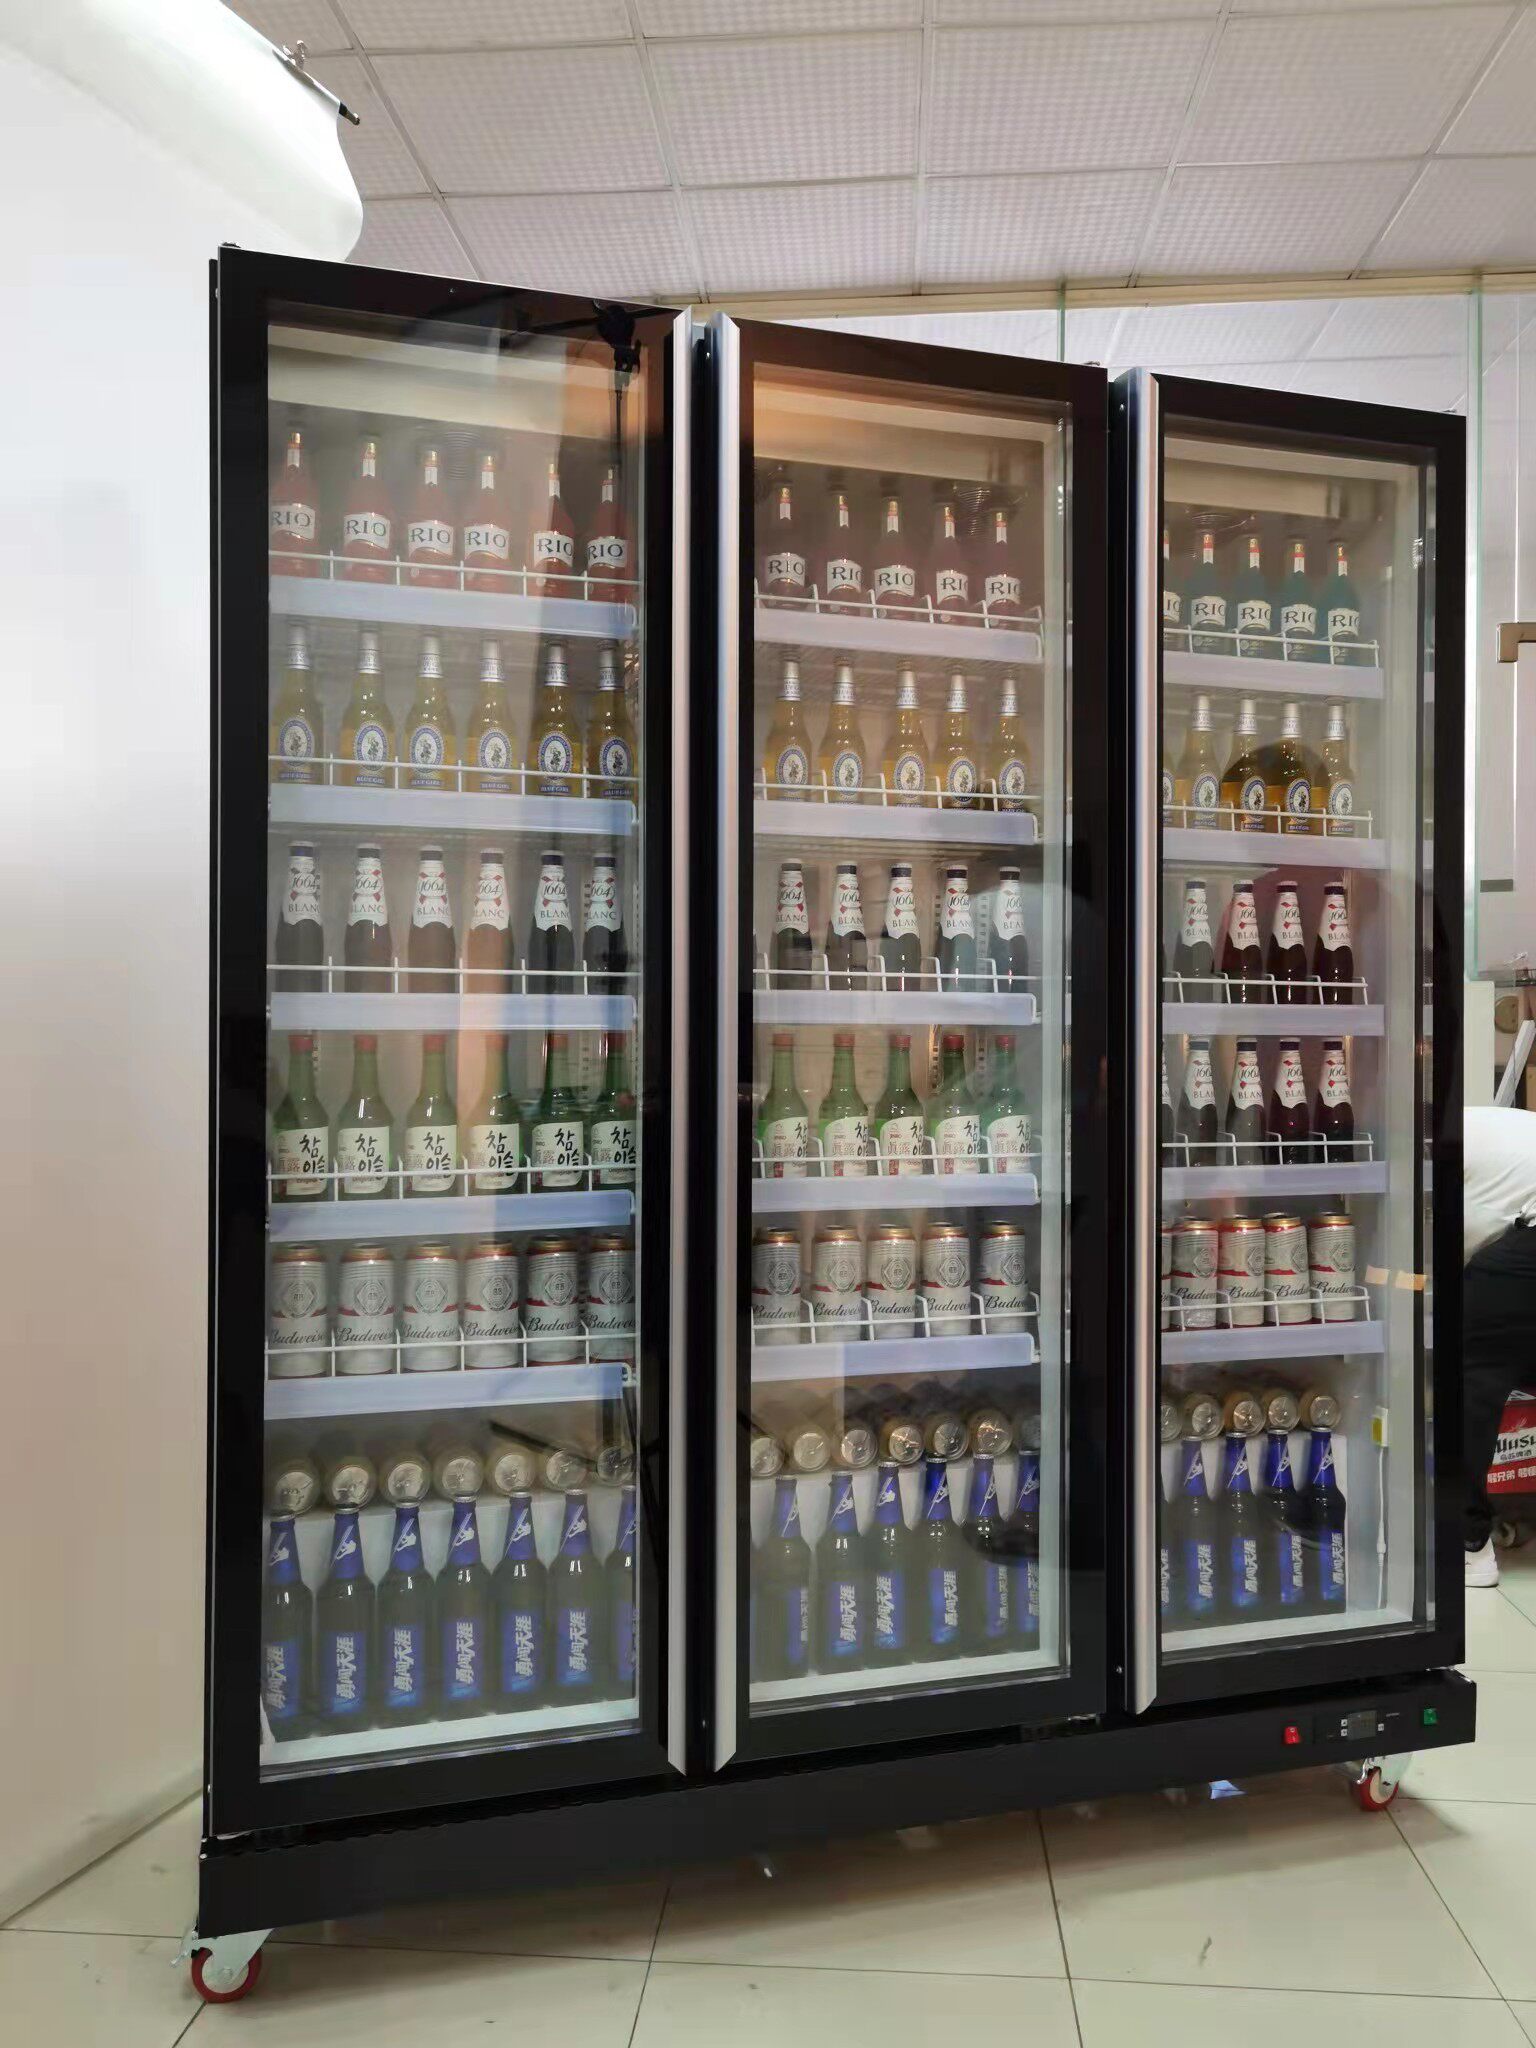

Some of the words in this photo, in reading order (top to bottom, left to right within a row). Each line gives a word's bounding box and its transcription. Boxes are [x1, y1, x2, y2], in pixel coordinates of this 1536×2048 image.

[271, 510, 311, 528] RIO
[345, 519, 387, 537] RIO
[409, 527, 451, 544] RIO
[465, 530, 507, 548] RIO
[537, 538, 574, 557] RIO
[586, 543, 624, 560] RIO
[767, 559, 805, 576] RIO
[878, 572, 914, 587] RIO
[419, 881, 445, 893] 1664
[543, 885, 567, 896] 1664
[841, 892, 861, 902] 166
[1240, 908, 1256, 918] 166
[1284, 908, 1301, 919] 166
[1330, 910, 1347, 920] 166
[1196, 1067, 1213, 1078] 166
[1287, 1067, 1303, 1078] 166
[1329, 1067, 1346, 1078] 166
[554, 1127, 577, 1151] 참
[610, 1126, 632, 1149] 참
[963, 1120, 979, 1142] 참
[299, 1134, 321, 1157] 참
[355, 1133, 378, 1157] 참
[423, 1131, 445, 1156] 참
[485, 1130, 508, 1154] 참
[1197, 1543, 1214, 1599] 勇闯天涯
[1243, 1539, 1259, 1593] 勇闯天涯
[876, 1575, 896, 1634] 勇闯天涯
[943, 1570, 959, 1627] 勇闯天涯
[839, 1584, 858, 1642] 勇闯天涯
[514, 1614, 535, 1677] 勇闯天涯
[568, 1610, 589, 1672] 勇闯天涯
[393, 1629, 415, 1693] 勇闯天涯
[455, 1621, 475, 1685] 勇闯天涯
[335, 1635, 357, 1700] 勇闯天涯
